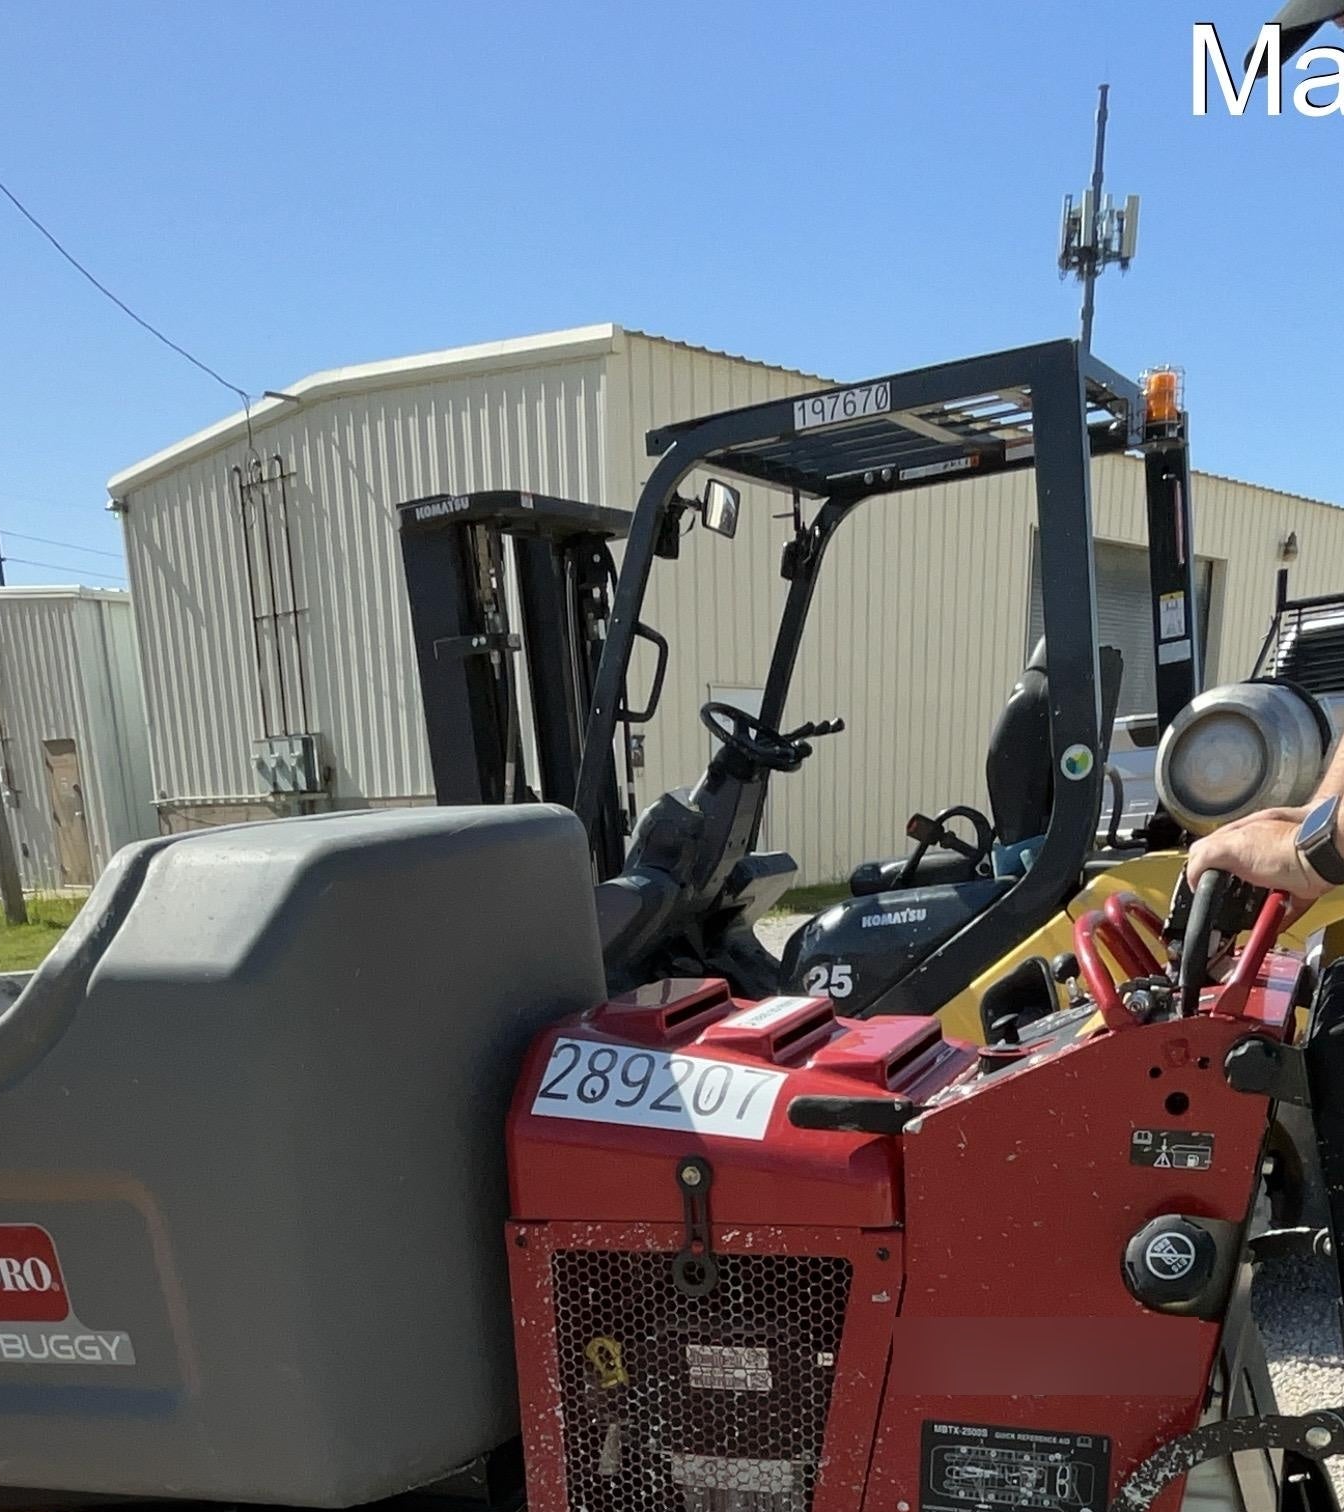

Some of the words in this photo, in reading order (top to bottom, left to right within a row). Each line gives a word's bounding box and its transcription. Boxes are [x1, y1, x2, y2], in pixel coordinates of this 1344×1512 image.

[797, 384, 889, 427] 197670
[415, 496, 470, 521] KOMATSU
[861, 908, 927, 928] KOMATSU
[808, 964, 853, 998] 25
[538, 1043, 778, 1120] 289207
[994, 1431, 1016, 1440] QUICK
[1017, 1433, 1057, 1444] REFERENCE
